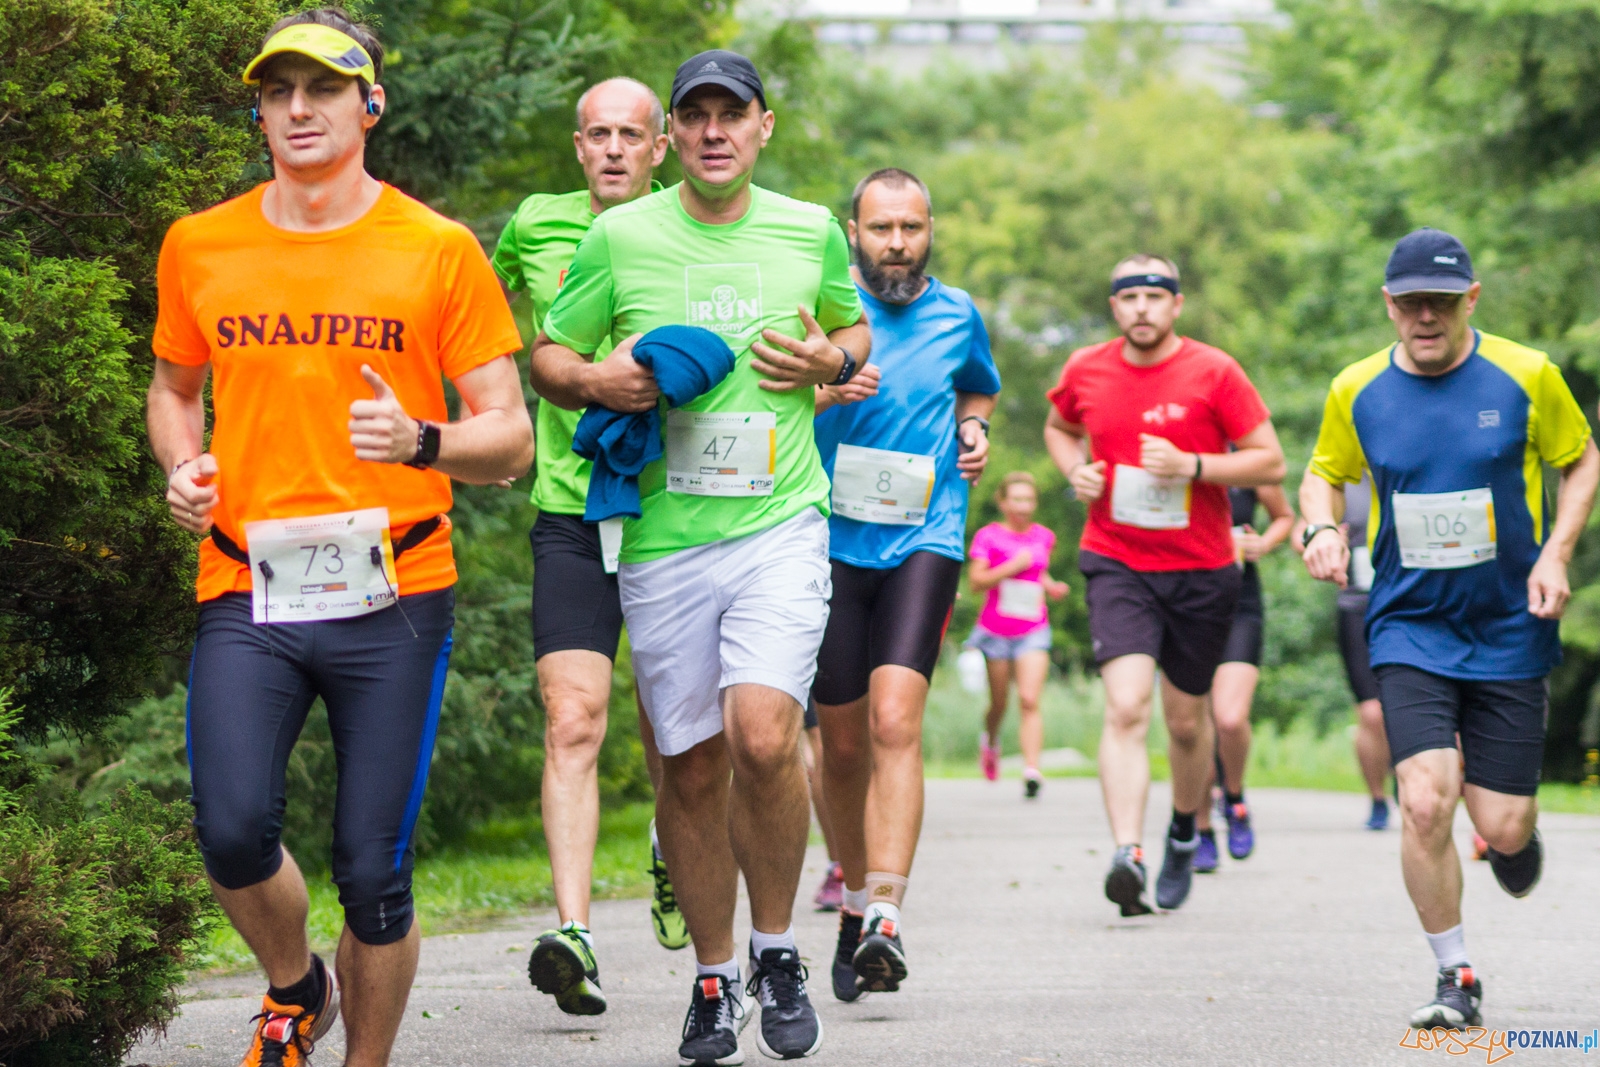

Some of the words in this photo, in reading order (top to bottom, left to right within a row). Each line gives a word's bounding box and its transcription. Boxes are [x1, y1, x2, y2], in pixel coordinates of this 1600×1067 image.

[698, 298, 759, 322] RUN
[217, 313, 404, 352] SNAJPER
[702, 436, 737, 460] 47
[876, 470, 891, 493] 8
[1422, 513, 1467, 536] 106
[300, 543, 344, 576] 73
